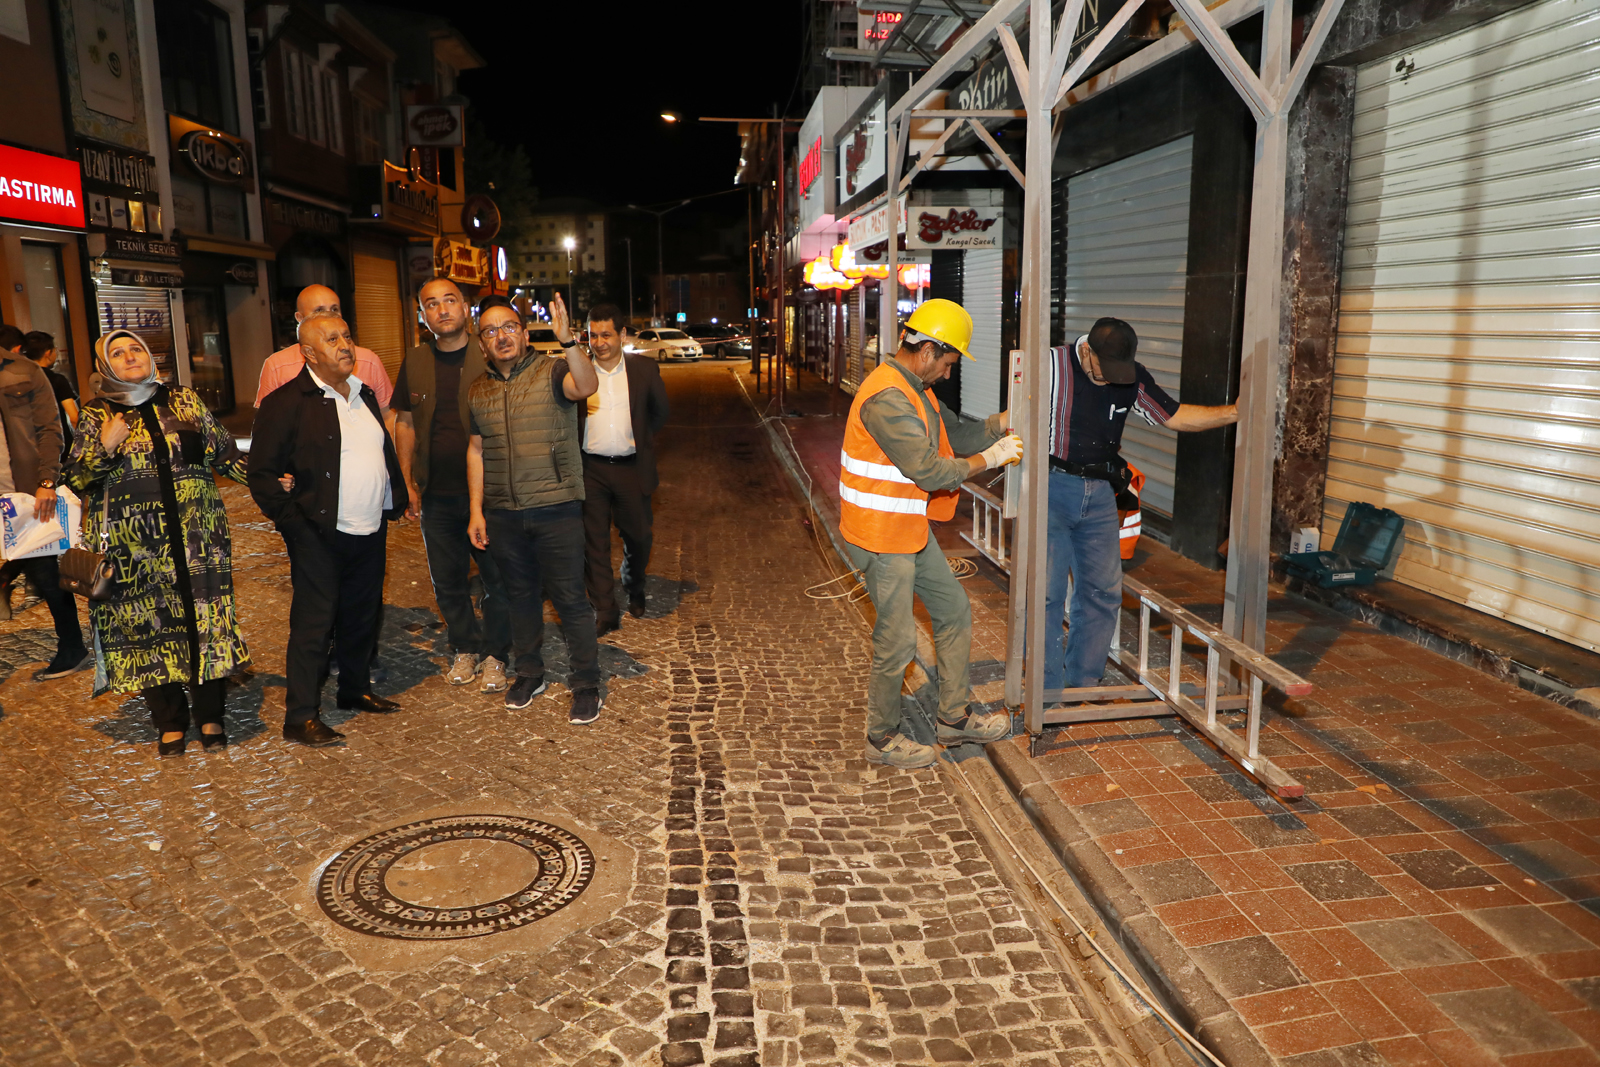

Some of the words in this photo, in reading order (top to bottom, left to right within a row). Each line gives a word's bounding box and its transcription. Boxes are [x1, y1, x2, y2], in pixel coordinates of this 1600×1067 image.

[958, 66, 1008, 110] Platin
[417, 112, 449, 125] ahmet
[424, 120, 453, 136] ipek
[83, 148, 110, 184] UZAY
[112, 151, 159, 195] İLETİŞİM
[195, 138, 245, 176] ikbal
[0, 176, 77, 208] ASTIRMA
[871, 200, 902, 239] PASTIA
[919, 208, 998, 243] Zekiler
[116, 239, 147, 253] TEKNİK
[148, 242, 176, 256] SERVİS
[946, 237, 972, 247] Kangal
[973, 237, 996, 247] Sucuk
[134, 273, 153, 283] UZAY
[154, 274, 182, 287] İLETİŞİM
